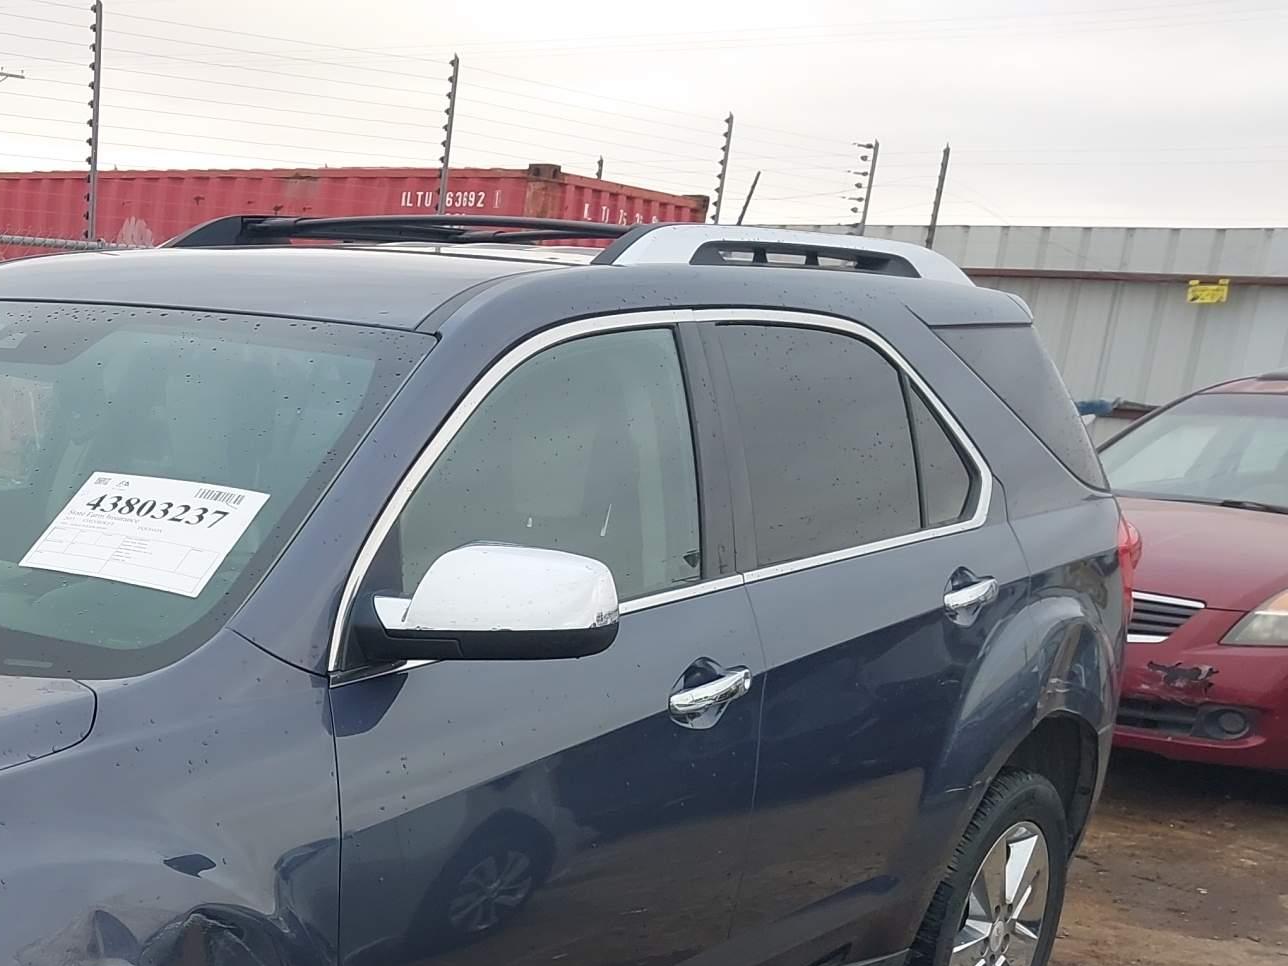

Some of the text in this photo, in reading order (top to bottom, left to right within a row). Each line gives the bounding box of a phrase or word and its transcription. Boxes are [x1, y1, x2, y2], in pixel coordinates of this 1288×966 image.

[401, 191, 433, 207] ILTU
[444, 191, 486, 208] 63692
[86, 493, 230, 529] 43803237
